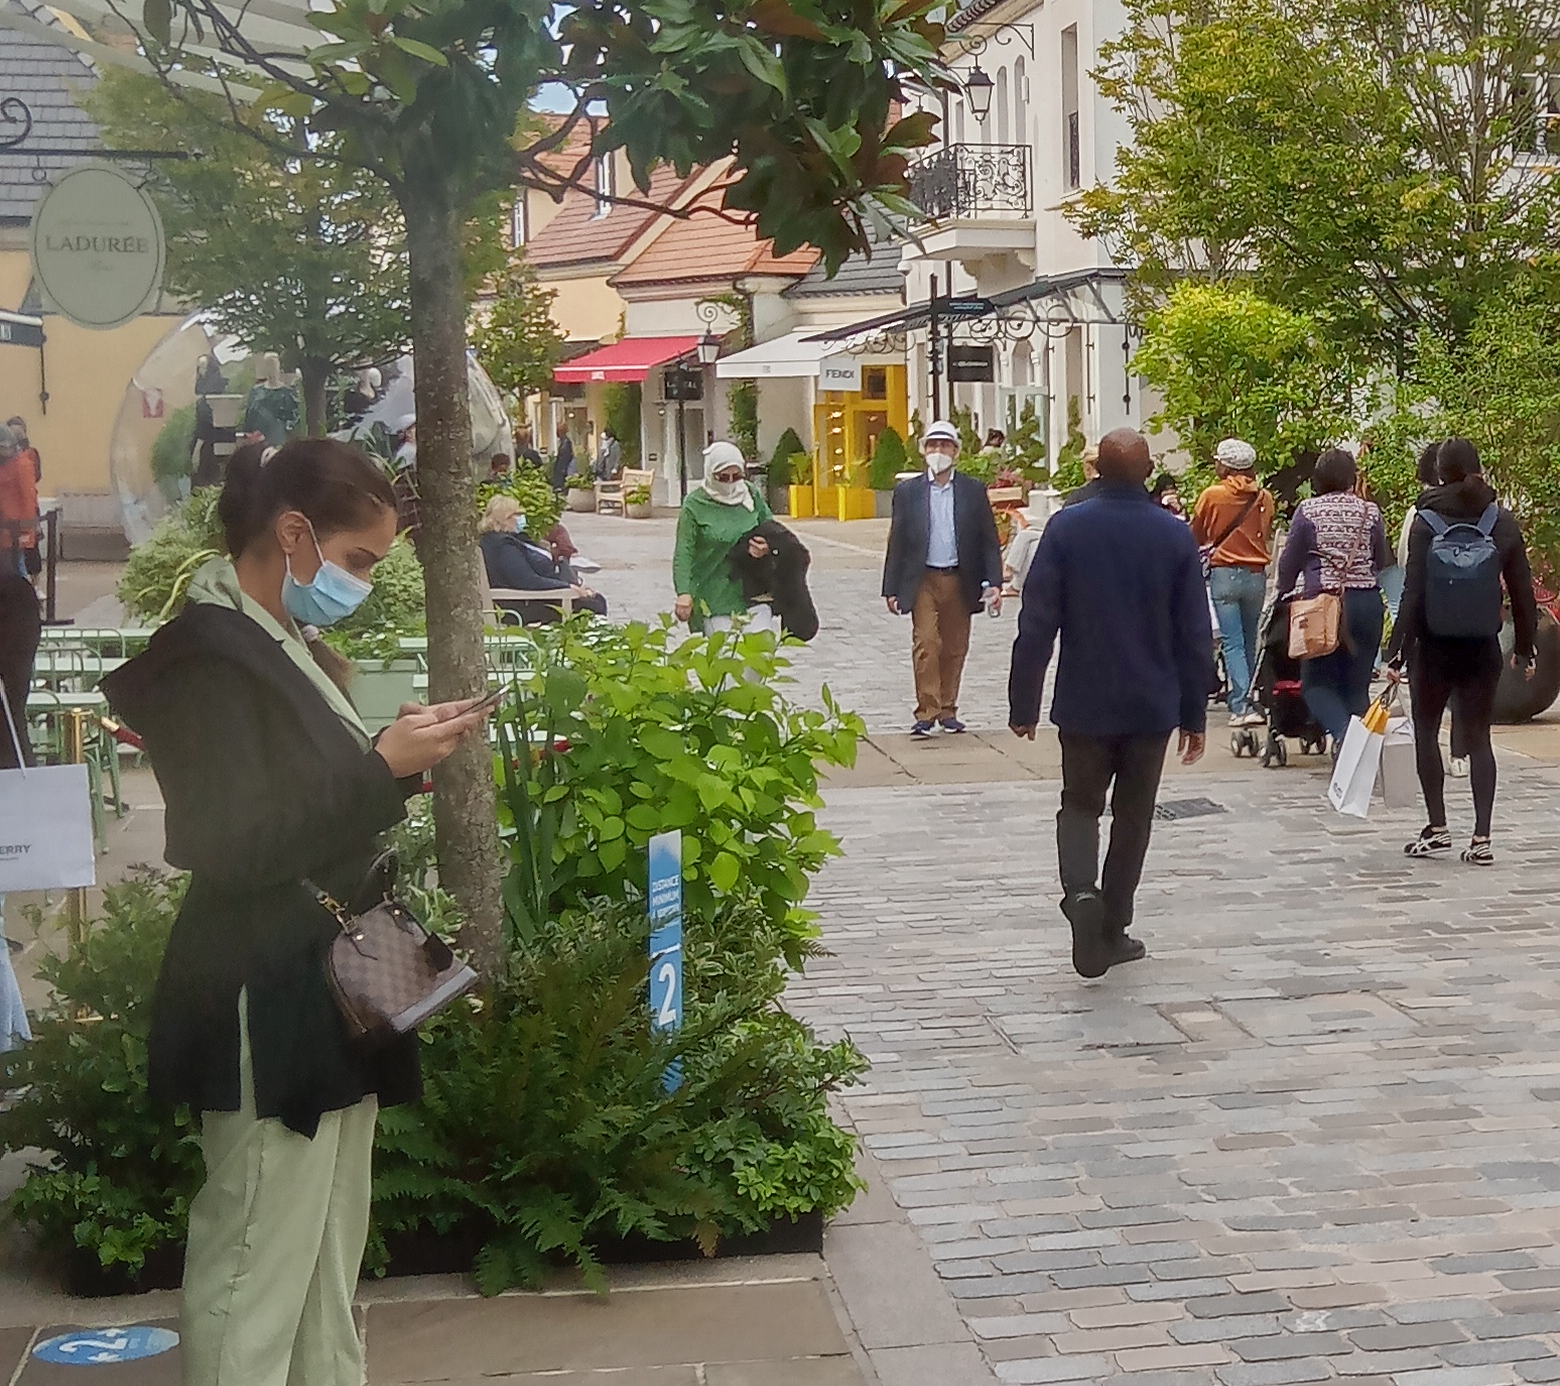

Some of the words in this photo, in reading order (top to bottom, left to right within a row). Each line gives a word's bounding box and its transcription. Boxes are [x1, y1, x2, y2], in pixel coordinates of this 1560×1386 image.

[45, 234, 149, 254] LADURÉE
[825, 369, 855, 378] FENDI
[652, 875, 679, 893] DISTANCE
[658, 963, 677, 1027] 2
[58, 1338, 128, 1353] 2
